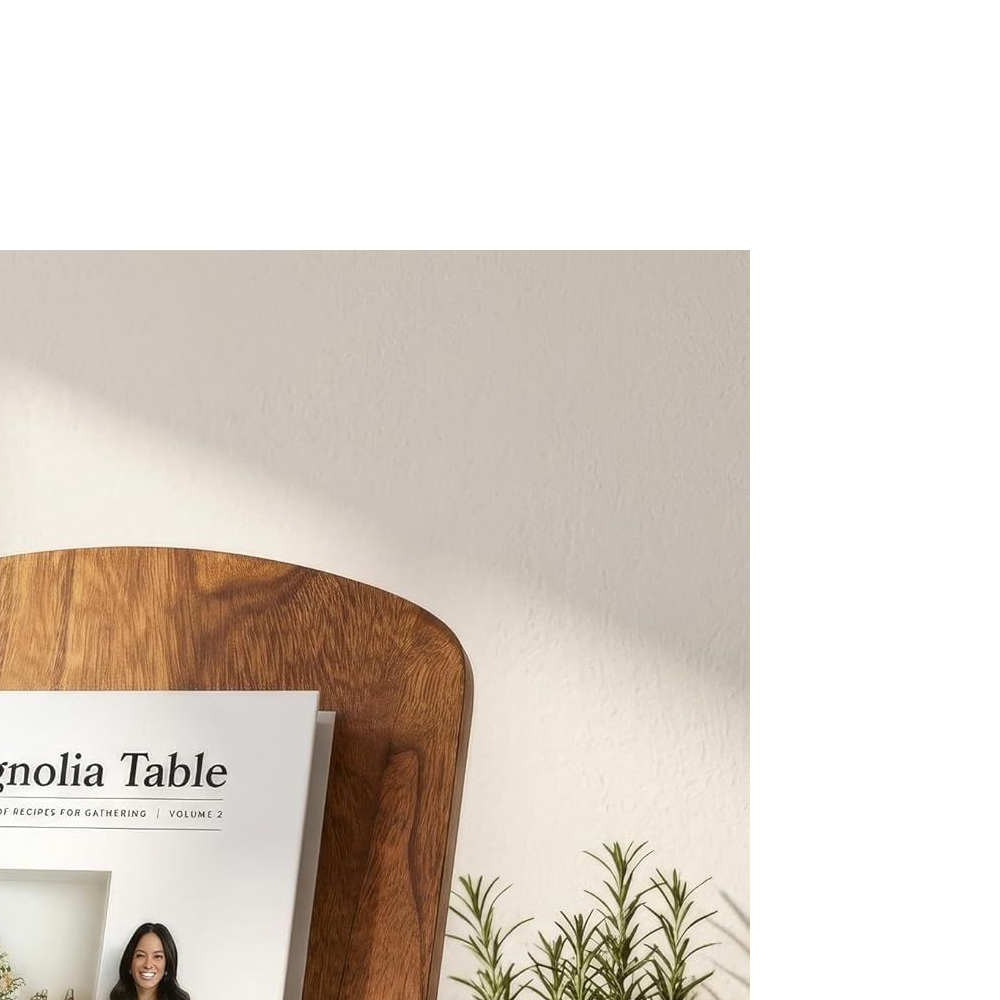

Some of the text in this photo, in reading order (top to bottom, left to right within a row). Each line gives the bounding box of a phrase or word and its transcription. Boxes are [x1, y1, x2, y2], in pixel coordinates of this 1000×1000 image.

[120, 751, 228, 788] Table
[12, 807, 56, 817] RECIPES
[59, 808, 81, 817] FOR
[84, 808, 147, 818] GATHERING
[168, 809, 213, 819] VOLUME
[216, 810, 223, 819] 2
